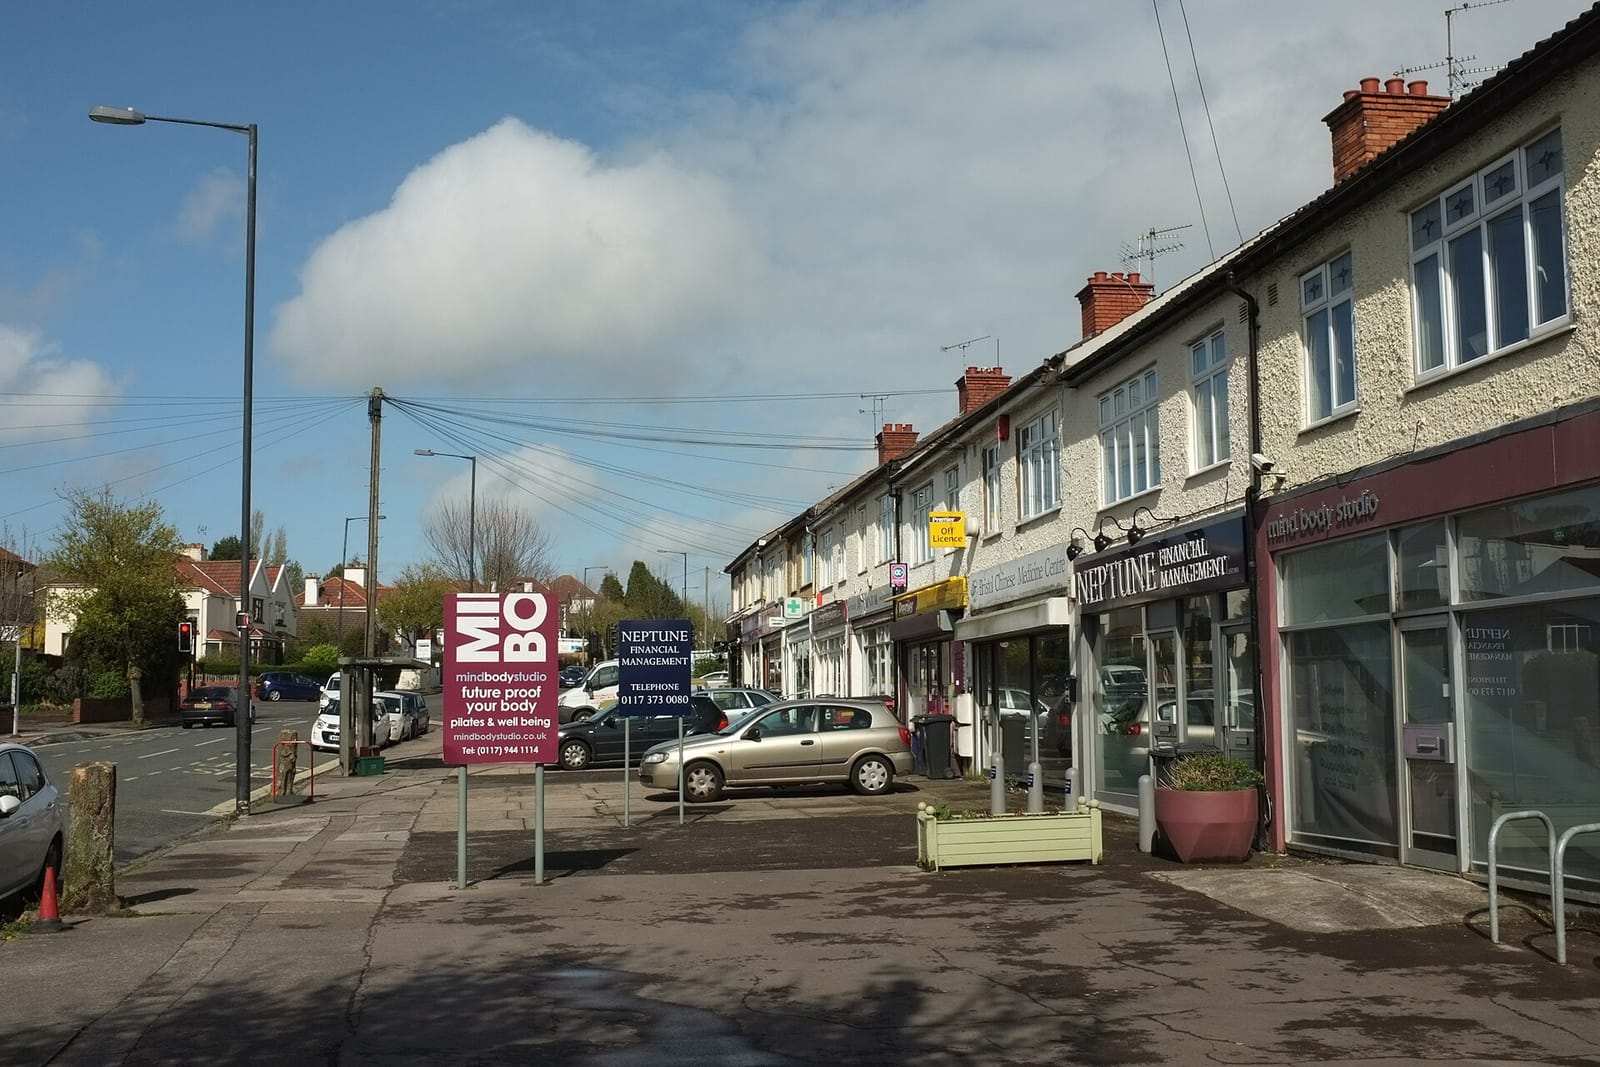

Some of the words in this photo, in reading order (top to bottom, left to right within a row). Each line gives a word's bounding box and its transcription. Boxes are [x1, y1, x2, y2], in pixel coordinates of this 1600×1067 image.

[1268, 509, 1298, 538] mind
[1300, 502, 1333, 530] body
[1337, 489, 1379, 521] studio
[941, 527, 954, 535] Off
[932, 535, 963, 543] Licence
[1158, 538, 1209, 567] FINANCIAL
[1044, 557, 1065, 577] Centre
[1159, 555, 1229, 589] MANAGEMENT
[1076, 552, 1158, 606] NEPTUNE
[621, 630, 689, 642] NEPTUNE
[630, 645, 680, 654] FINANCIAL
[621, 657, 689, 666] MANAGEMENT
[456, 672, 547, 684] mindbodystudio
[462, 686, 502, 698] future
[505, 685, 541, 701] proof
[630, 683, 680, 691] TELEPHONE
[621, 695, 644, 705] 0117
[647, 695, 663, 705] 373
[665, 694, 689, 704] 0080
[466, 702, 497, 715] your
[500, 699, 537, 714] body
[450, 717, 485, 729] pilates
[487, 717, 495, 727] &
[497, 716, 518, 726] well
[520, 716, 551, 728] being
[453, 732, 547, 742] mindbodystudio.co.uk
[477, 746, 502, 756] (0117)
[504, 746, 518, 754] 944
[520, 746, 539, 754] 1114
